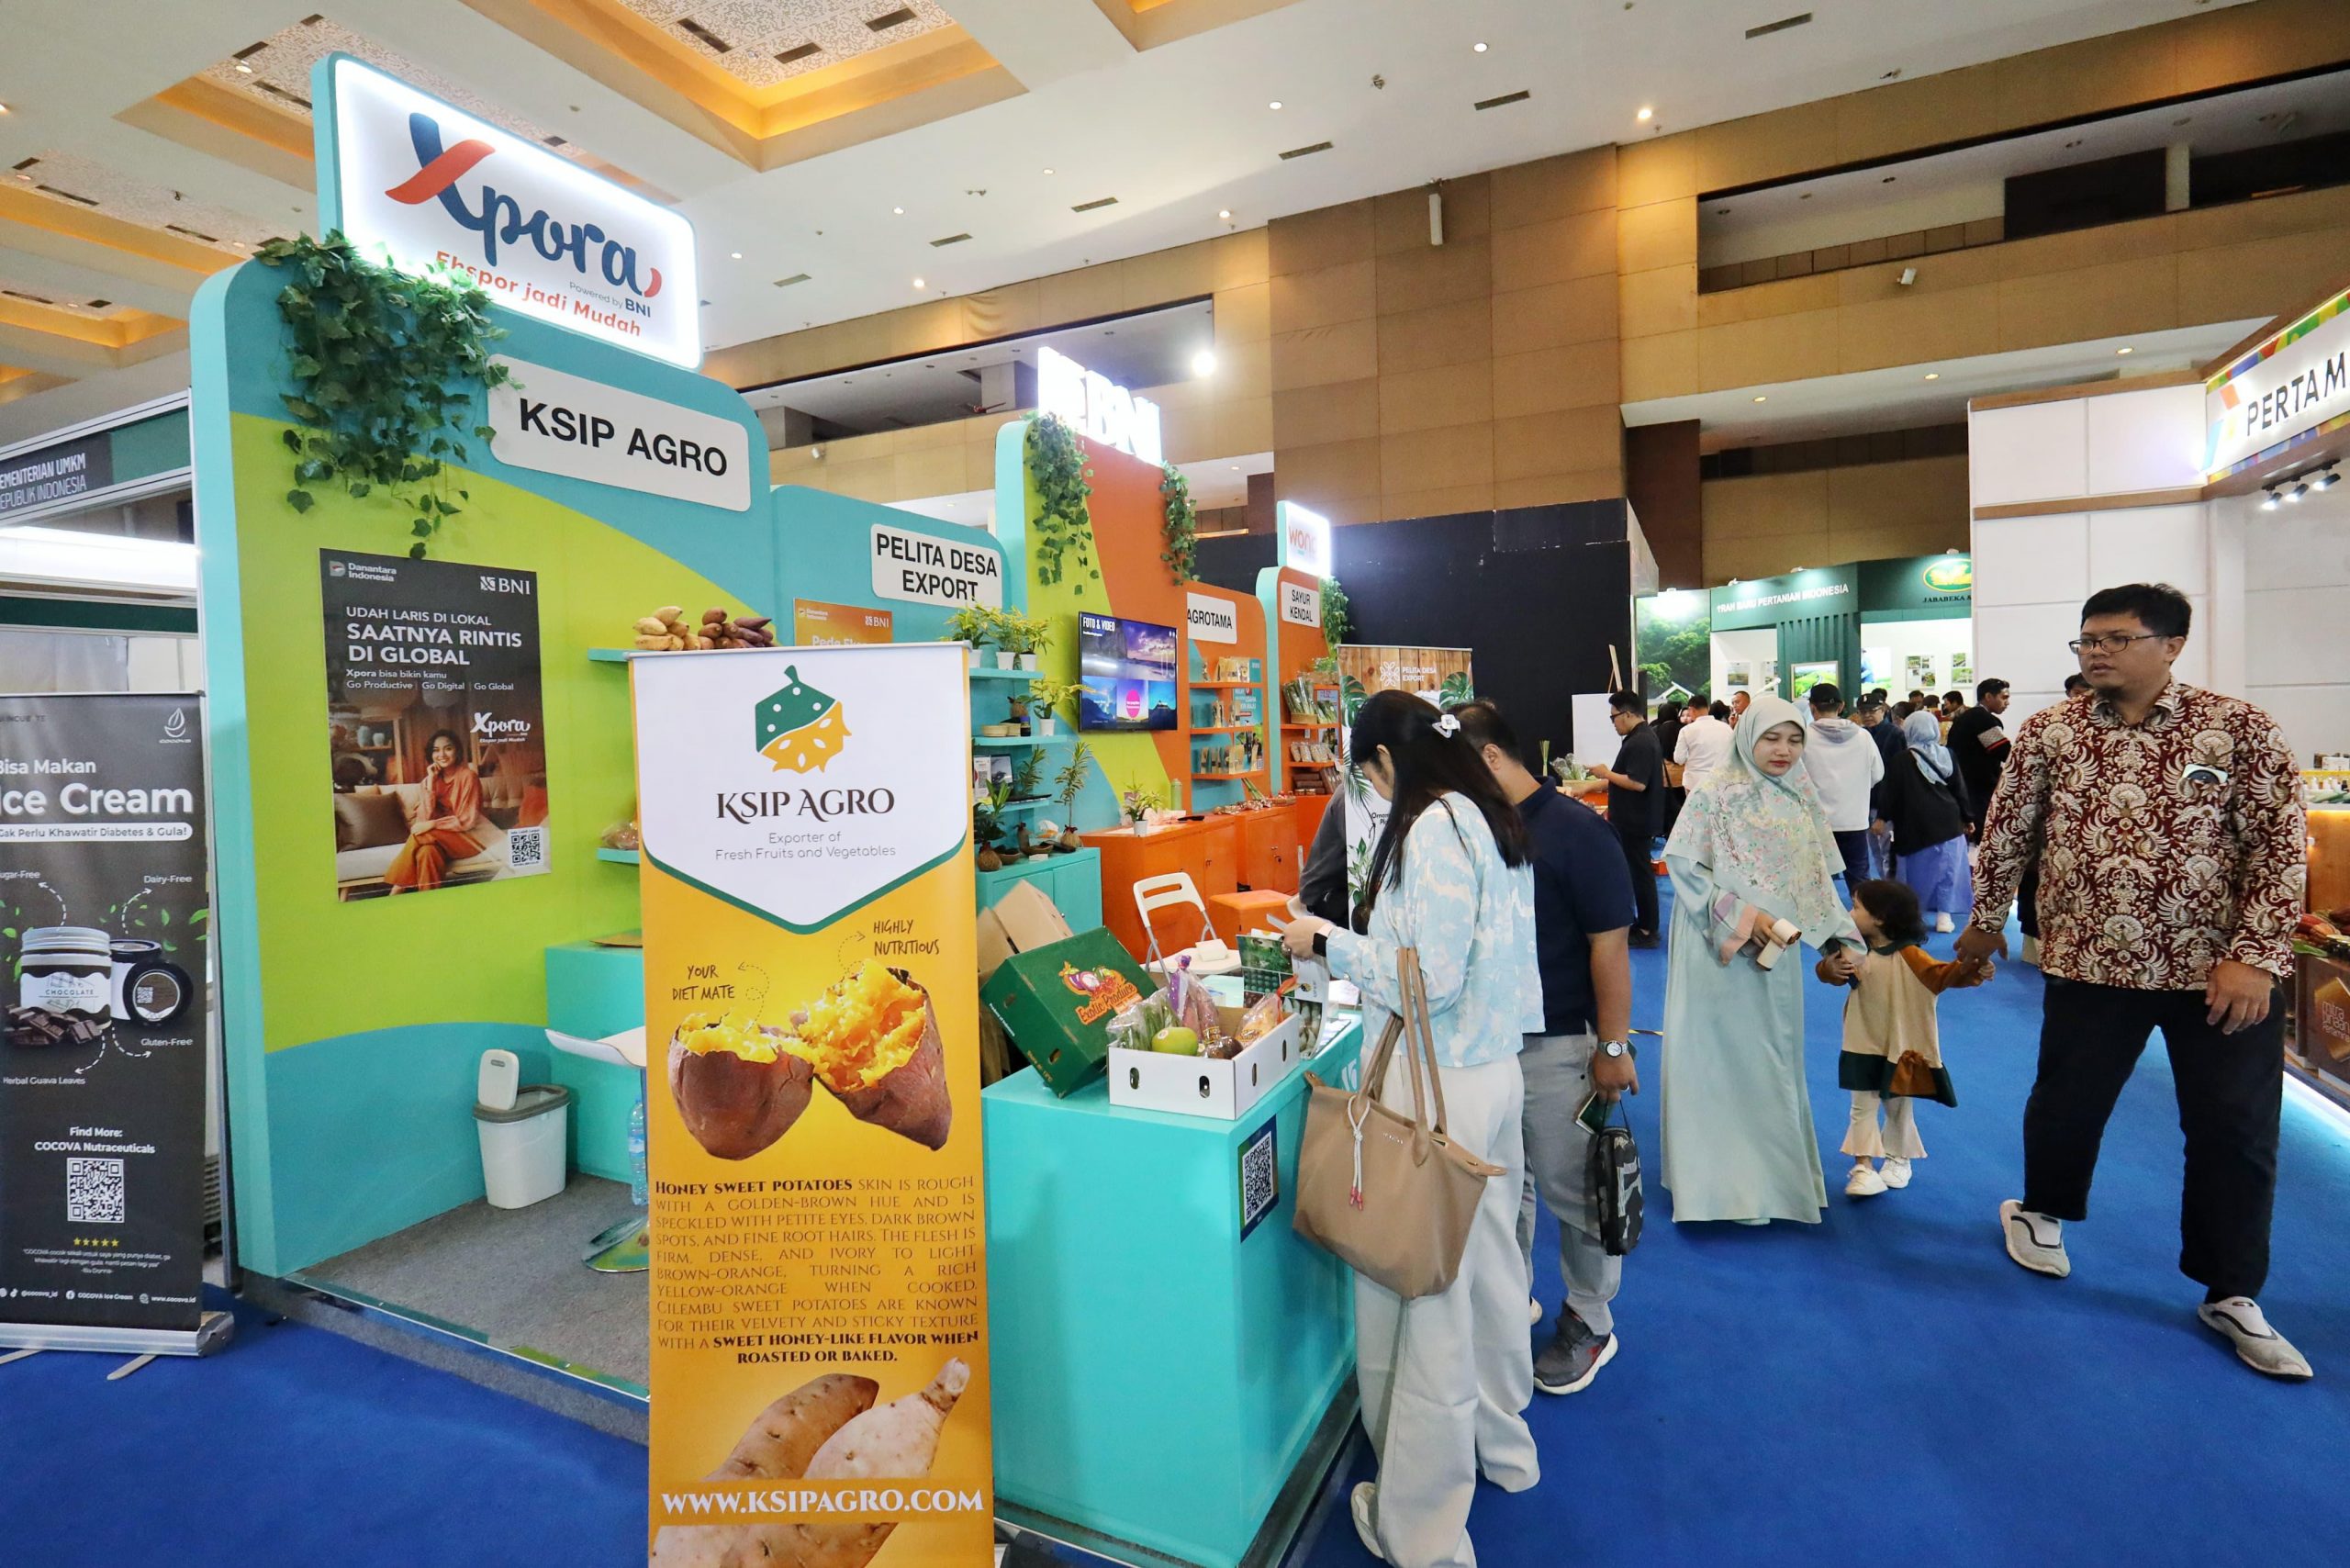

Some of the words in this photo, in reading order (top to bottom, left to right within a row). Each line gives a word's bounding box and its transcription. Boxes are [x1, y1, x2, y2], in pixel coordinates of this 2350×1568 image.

[385, 112, 662, 297] Xpora
[569, 281, 611, 304] Powered
[611, 297, 622, 309] by
[625, 297, 652, 318] BNI
[521, 282, 567, 310] jadi
[574, 300, 642, 337] Mudah
[2247, 352, 2350, 436] PERTAM
[520, 398, 616, 449] KSIP
[627, 428, 728, 476] AGRO
[56, 453, 86, 475] UMKM
[37, 475, 87, 500] INDONESIA
[877, 533, 946, 567] PELITA
[950, 549, 998, 577] DESA
[348, 562, 397, 575] Danantara
[348, 570, 395, 582] Indonesia
[498, 578, 531, 595] BNI
[902, 569, 979, 601] EXPORT
[1292, 589, 1311, 606] SAYUR
[1757, 592, 1801, 607] PERTANIAN
[1801, 584, 1850, 599] INDONESIA
[346, 606, 388, 620] UDAH
[393, 610, 430, 622] LARIS
[433, 612, 447, 623] DI
[451, 613, 493, 626] LOKAL
[873, 617, 890, 628] BNI
[1187, 608, 1233, 630] AGROTAMA
[1290, 606, 1314, 622] KENDAL
[1082, 617, 1095, 629] FOTO
[1096, 619, 1101, 630] &
[1101, 620, 1115, 632] VIDEO
[347, 622, 453, 644] SAATNYA
[459, 631, 523, 647] RINTIS
[349, 645, 374, 661] DI
[380, 647, 471, 666] GLOBAL
[346, 668, 377, 679] Xpora
[378, 668, 397, 678] bisa
[399, 669, 421, 678] bikin
[423, 669, 447, 679] kamu
[346, 681, 362, 689] Go
[364, 681, 413, 689] Productive
[421, 682, 436, 690] Go
[437, 682, 465, 691] Digital
[474, 682, 487, 690] Go
[488, 682, 515, 691] Global
[470, 712, 531, 738] Xpora
[0, 759, 29, 775] Bisa
[33, 758, 96, 775] Makan
[60, 782, 194, 815] Cream
[716, 791, 791, 824] KSIP
[797, 788, 895, 823] AGRO
[17, 829, 46, 838] Perlu
[49, 828, 98, 837] Khawatir
[100, 827, 144, 836] Diabetes
[146, 827, 154, 836] &
[157, 826, 187, 836] Gula!
[768, 832, 825, 846] Exporter
[828, 830, 842, 843] of
[715, 847, 753, 861] Fresh
[755, 846, 794, 859] Fruits
[797, 845, 822, 858] and
[825, 845, 896, 860] Vegetables
[144, 875, 193, 884] Dairy-Free
[873, 919, 914, 935] HIGHLY
[874, 938, 940, 957] NUTRITIOUS
[687, 963, 719, 980] YOUR
[672, 986, 699, 1001] DIET
[700, 984, 735, 1000] MATE
[1078, 1002, 1104, 1023] Exotic
[1102, 984, 1136, 1005] Produce
[140, 1038, 194, 1047] Gluten-Free
[29, 1077, 57, 1085] Guava
[58, 1077, 86, 1085] Leaves
[69, 1126, 93, 1137] Find
[95, 1127, 123, 1137] More:
[34, 1141, 82, 1151] COCOVA
[83, 1143, 156, 1154] Nutraceuticals
[655, 1181, 709, 1195] HONEY
[714, 1181, 767, 1194] SWEET
[772, 1180, 853, 1193] POTATOES
[858, 1179, 892, 1191] SKIN
[899, 1178, 912, 1191] IS
[917, 1176, 973, 1191] ROUGH
[655, 1200, 691, 1213] WITH
[727, 1196, 856, 1211] GOLDEN-BROWN
[870, 1196, 901, 1208] HUE
[963, 1193, 975, 1205] IS
[655, 1215, 727, 1230] SPECKLED
[731, 1215, 771, 1227] WITH
[777, 1213, 826, 1226] PETITE
[871, 1213, 912, 1225] DARK
[917, 1210, 975, 1226] BROWN
[655, 1233, 699, 1248] SPOTS,
[744, 1231, 778, 1245] FINE
[783, 1230, 824, 1243] ROOT
[880, 1228, 911, 1242] THE
[913, 1228, 958, 1242] FLESH
[830, 1247, 877, 1260] IVORY
[929, 1244, 977, 1260] LIGHT
[657, 1265, 787, 1281] BROWN-ORANGE,
[810, 1263, 881, 1277] TURNING
[937, 1261, 977, 1276] RICH
[657, 1282, 788, 1298] YELLOW-ORANGE
[824, 1282, 871, 1294] WHEN
[656, 1300, 722, 1316] CILEMBU
[733, 1299, 781, 1314] SWEET
[792, 1298, 867, 1312] POTATOES
[877, 1298, 905, 1311] ARE
[915, 1295, 978, 1311] KNOWN
[657, 1318, 684, 1333] FOR
[689, 1318, 735, 1332] THEIR
[741, 1316, 807, 1330] VELVETY
[852, 1315, 904, 1328] STICKY
[910, 1314, 979, 1328] TEXTURE
[658, 1337, 694, 1350] WITH
[713, 1335, 766, 1349] SWEET
[769, 1333, 867, 1346] HONEY-LIKE
[868, 1333, 927, 1345] FLAVOR
[931, 1330, 979, 1345] WHEN
[738, 1351, 811, 1364] ROASTED
[815, 1350, 838, 1362] OR
[842, 1350, 898, 1362] BAKED.
[661, 1488, 984, 1516] WWW.KSIPAGRO.COM
